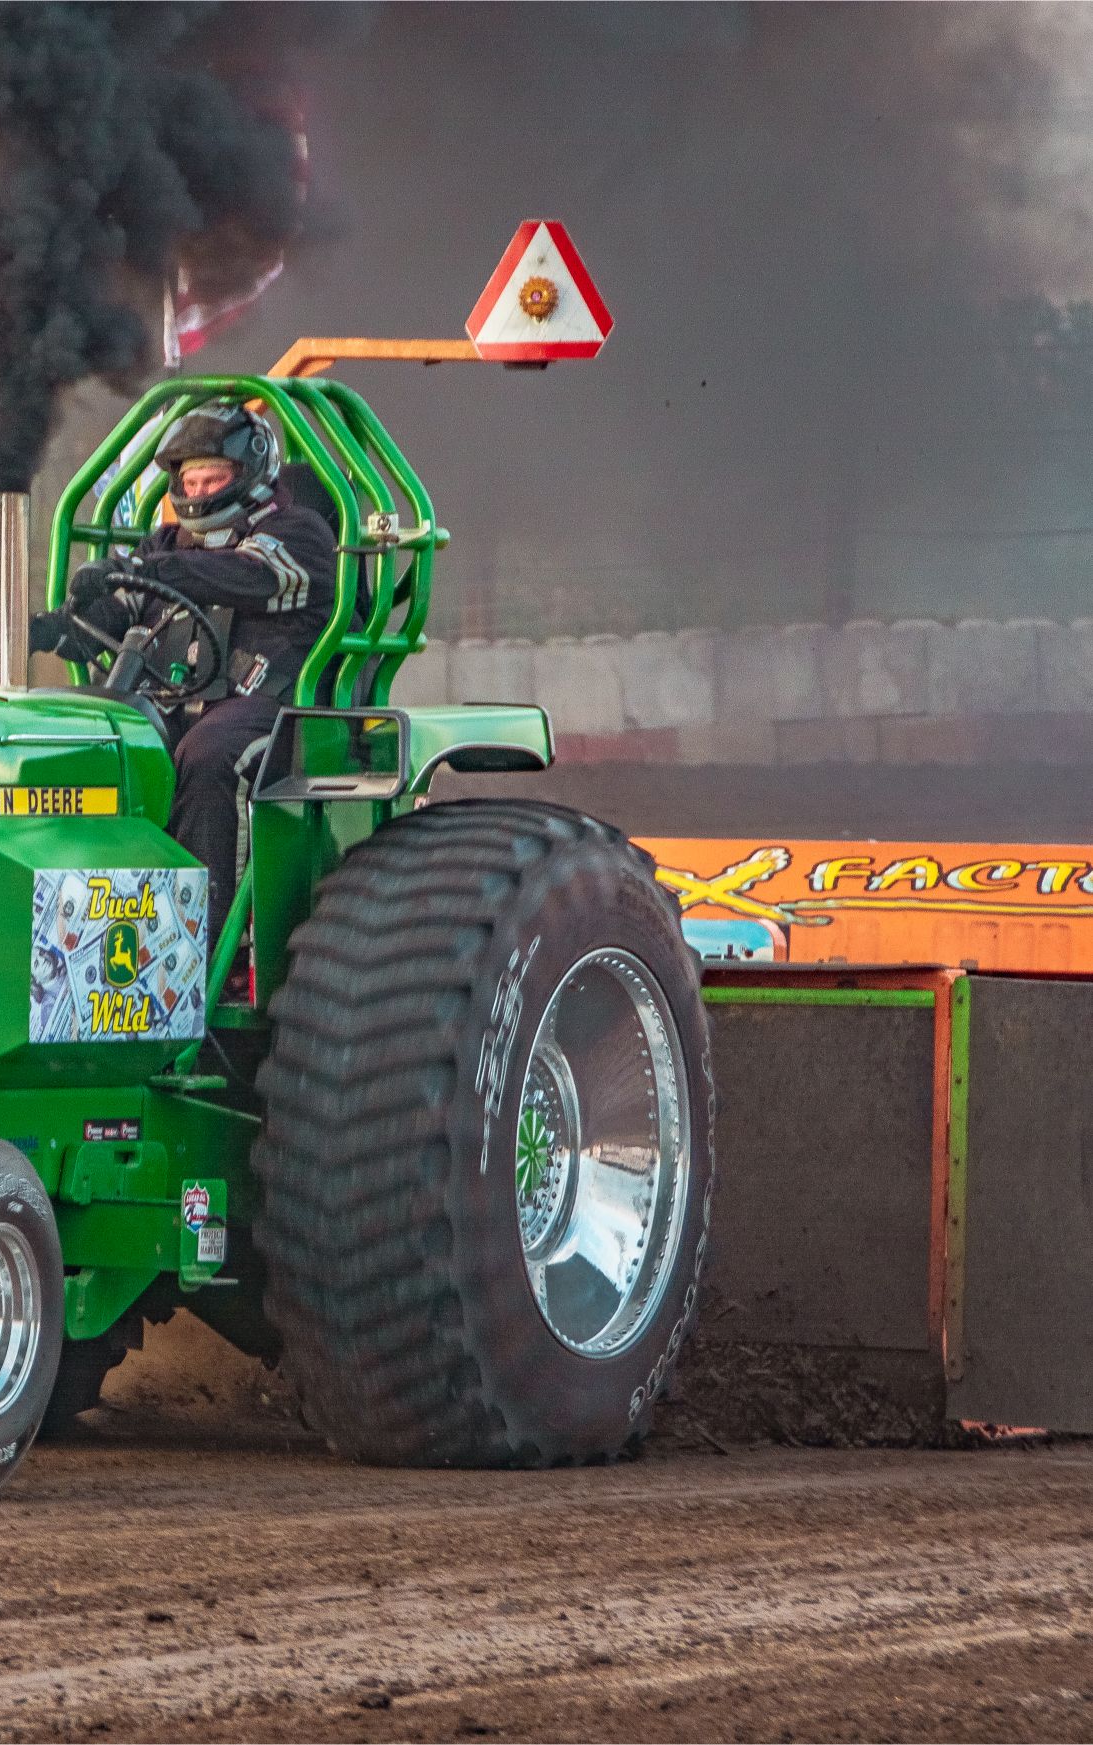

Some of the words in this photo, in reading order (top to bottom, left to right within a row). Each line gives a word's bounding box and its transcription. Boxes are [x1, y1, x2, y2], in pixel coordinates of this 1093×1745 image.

[27, 787, 84, 814] DEERE
[807, 855, 1093, 895] FACT
[87, 876, 157, 920] Buck
[88, 990, 150, 1034] Wild
